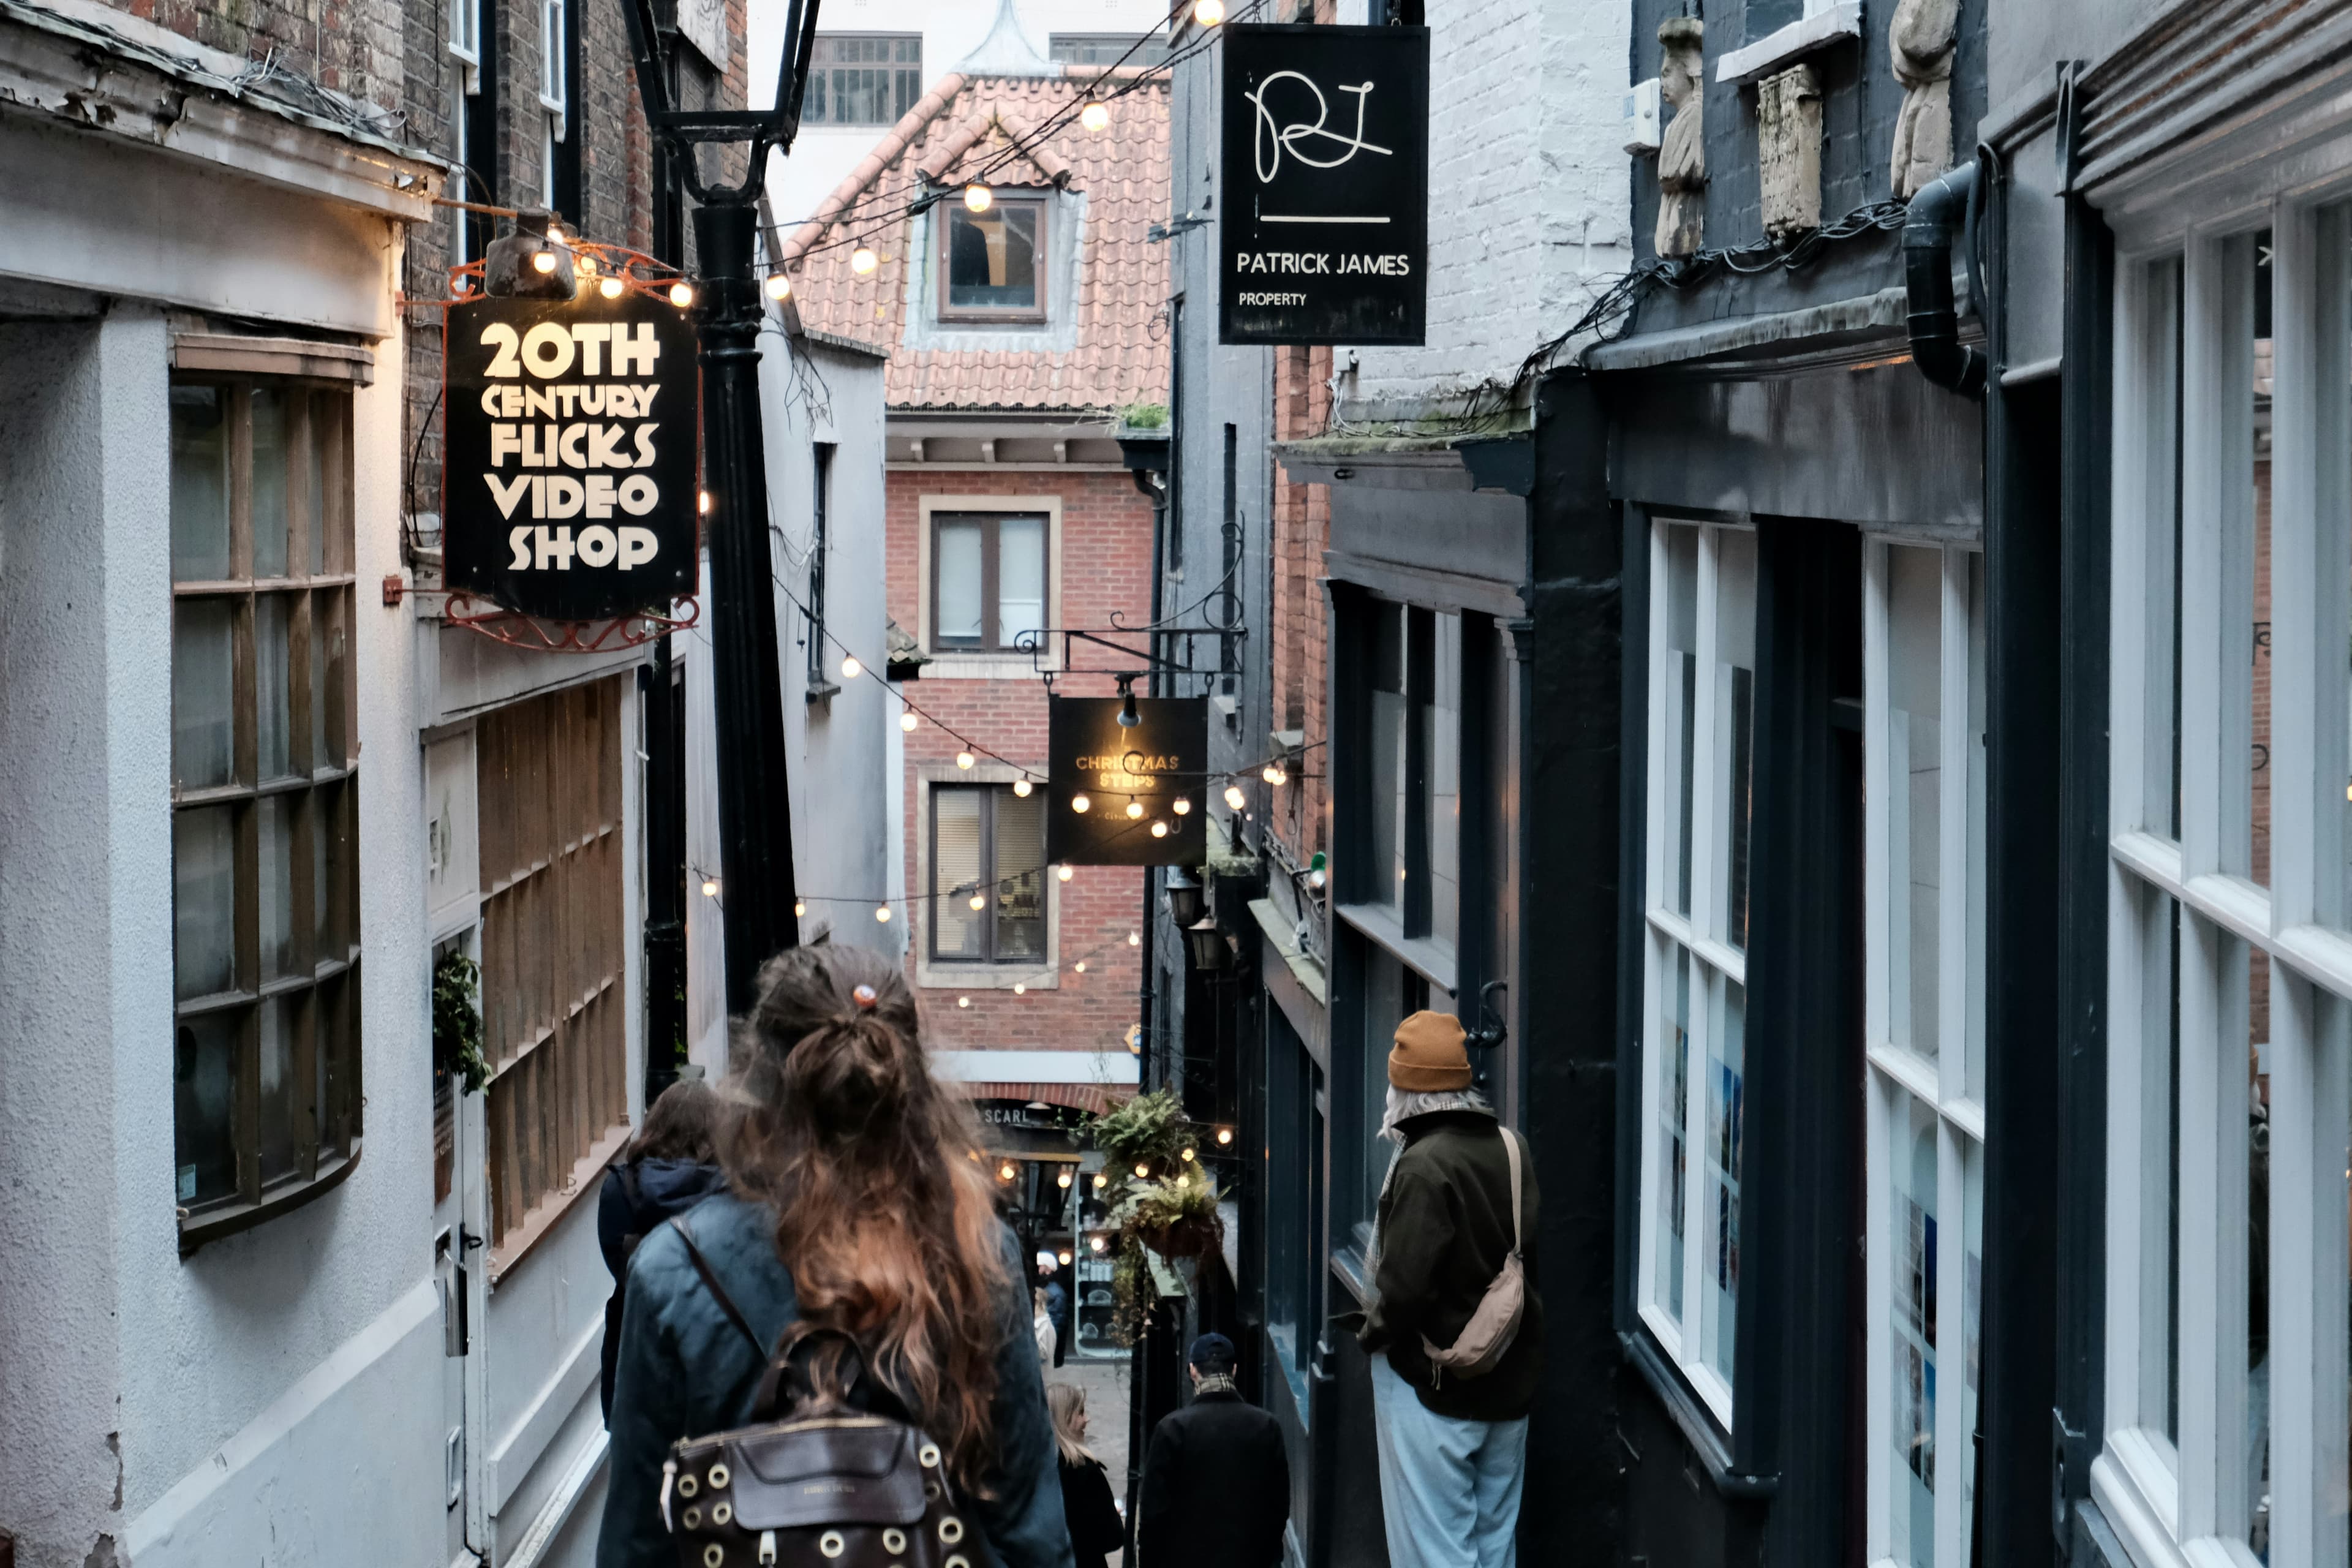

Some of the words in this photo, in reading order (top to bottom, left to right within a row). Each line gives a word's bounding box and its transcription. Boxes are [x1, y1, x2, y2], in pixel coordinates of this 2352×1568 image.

[1237, 252, 1330, 274] PATRICK
[1336, 254, 1409, 276] JAMES
[1239, 292, 1307, 306] PROPERTY
[480, 322, 660, 379] 20TH
[481, 384, 660, 420] CENTURY
[491, 423, 660, 469] FLICKS
[483, 473, 659, 520] VIDEO
[507, 525, 658, 570] SHOP
[1076, 755, 1180, 770] CHRISTMAS
[1099, 772, 1156, 788] STEPS
